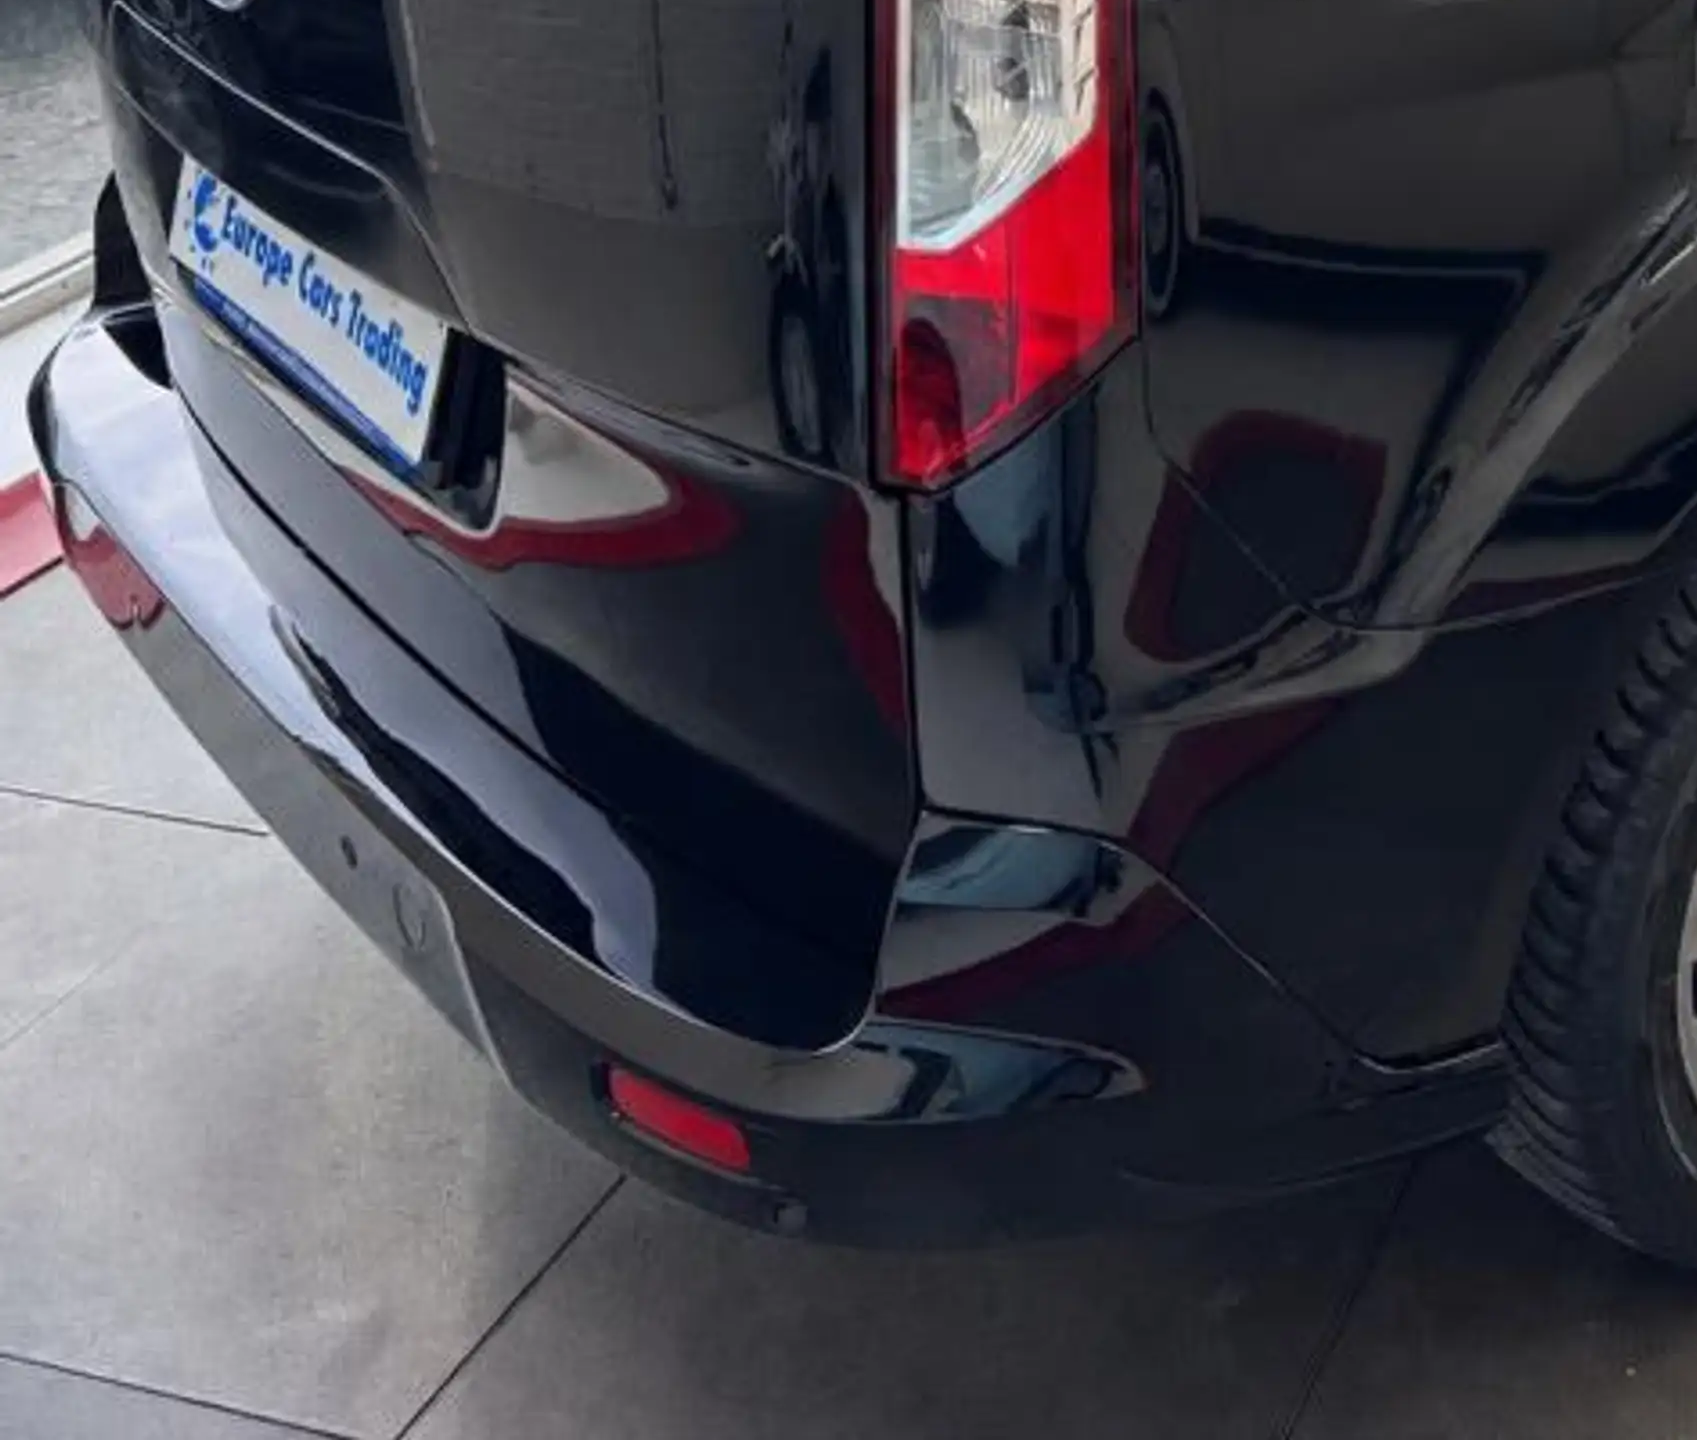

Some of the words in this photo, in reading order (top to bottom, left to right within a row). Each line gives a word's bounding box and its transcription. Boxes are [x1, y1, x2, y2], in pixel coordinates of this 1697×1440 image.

[220, 194, 293, 288] Europe
[299, 250, 343, 328] Cars
[347, 288, 429, 417] Trading
